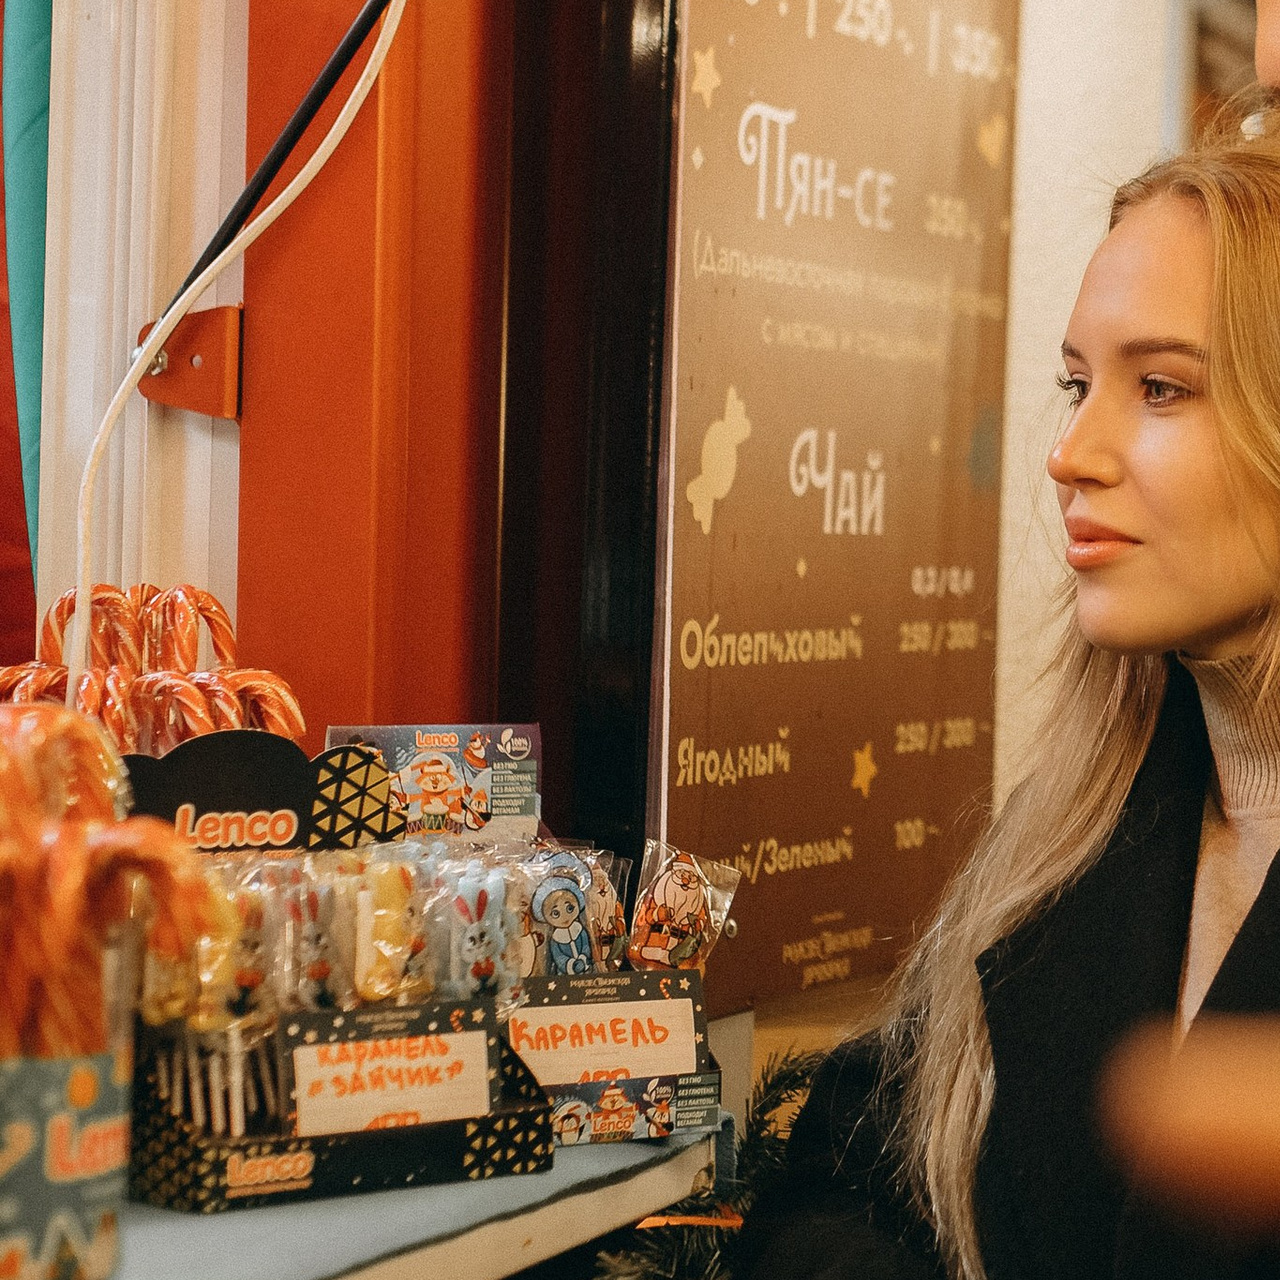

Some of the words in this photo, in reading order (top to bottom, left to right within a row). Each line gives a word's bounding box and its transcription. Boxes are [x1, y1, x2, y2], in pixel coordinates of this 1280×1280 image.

[415, 729, 459, 748] Lenco
[175, 803, 299, 849] Lenco
[509, 1017, 669, 1052] КАРАМЕЛЬ
[592, 1117, 632, 1133] Lenco
